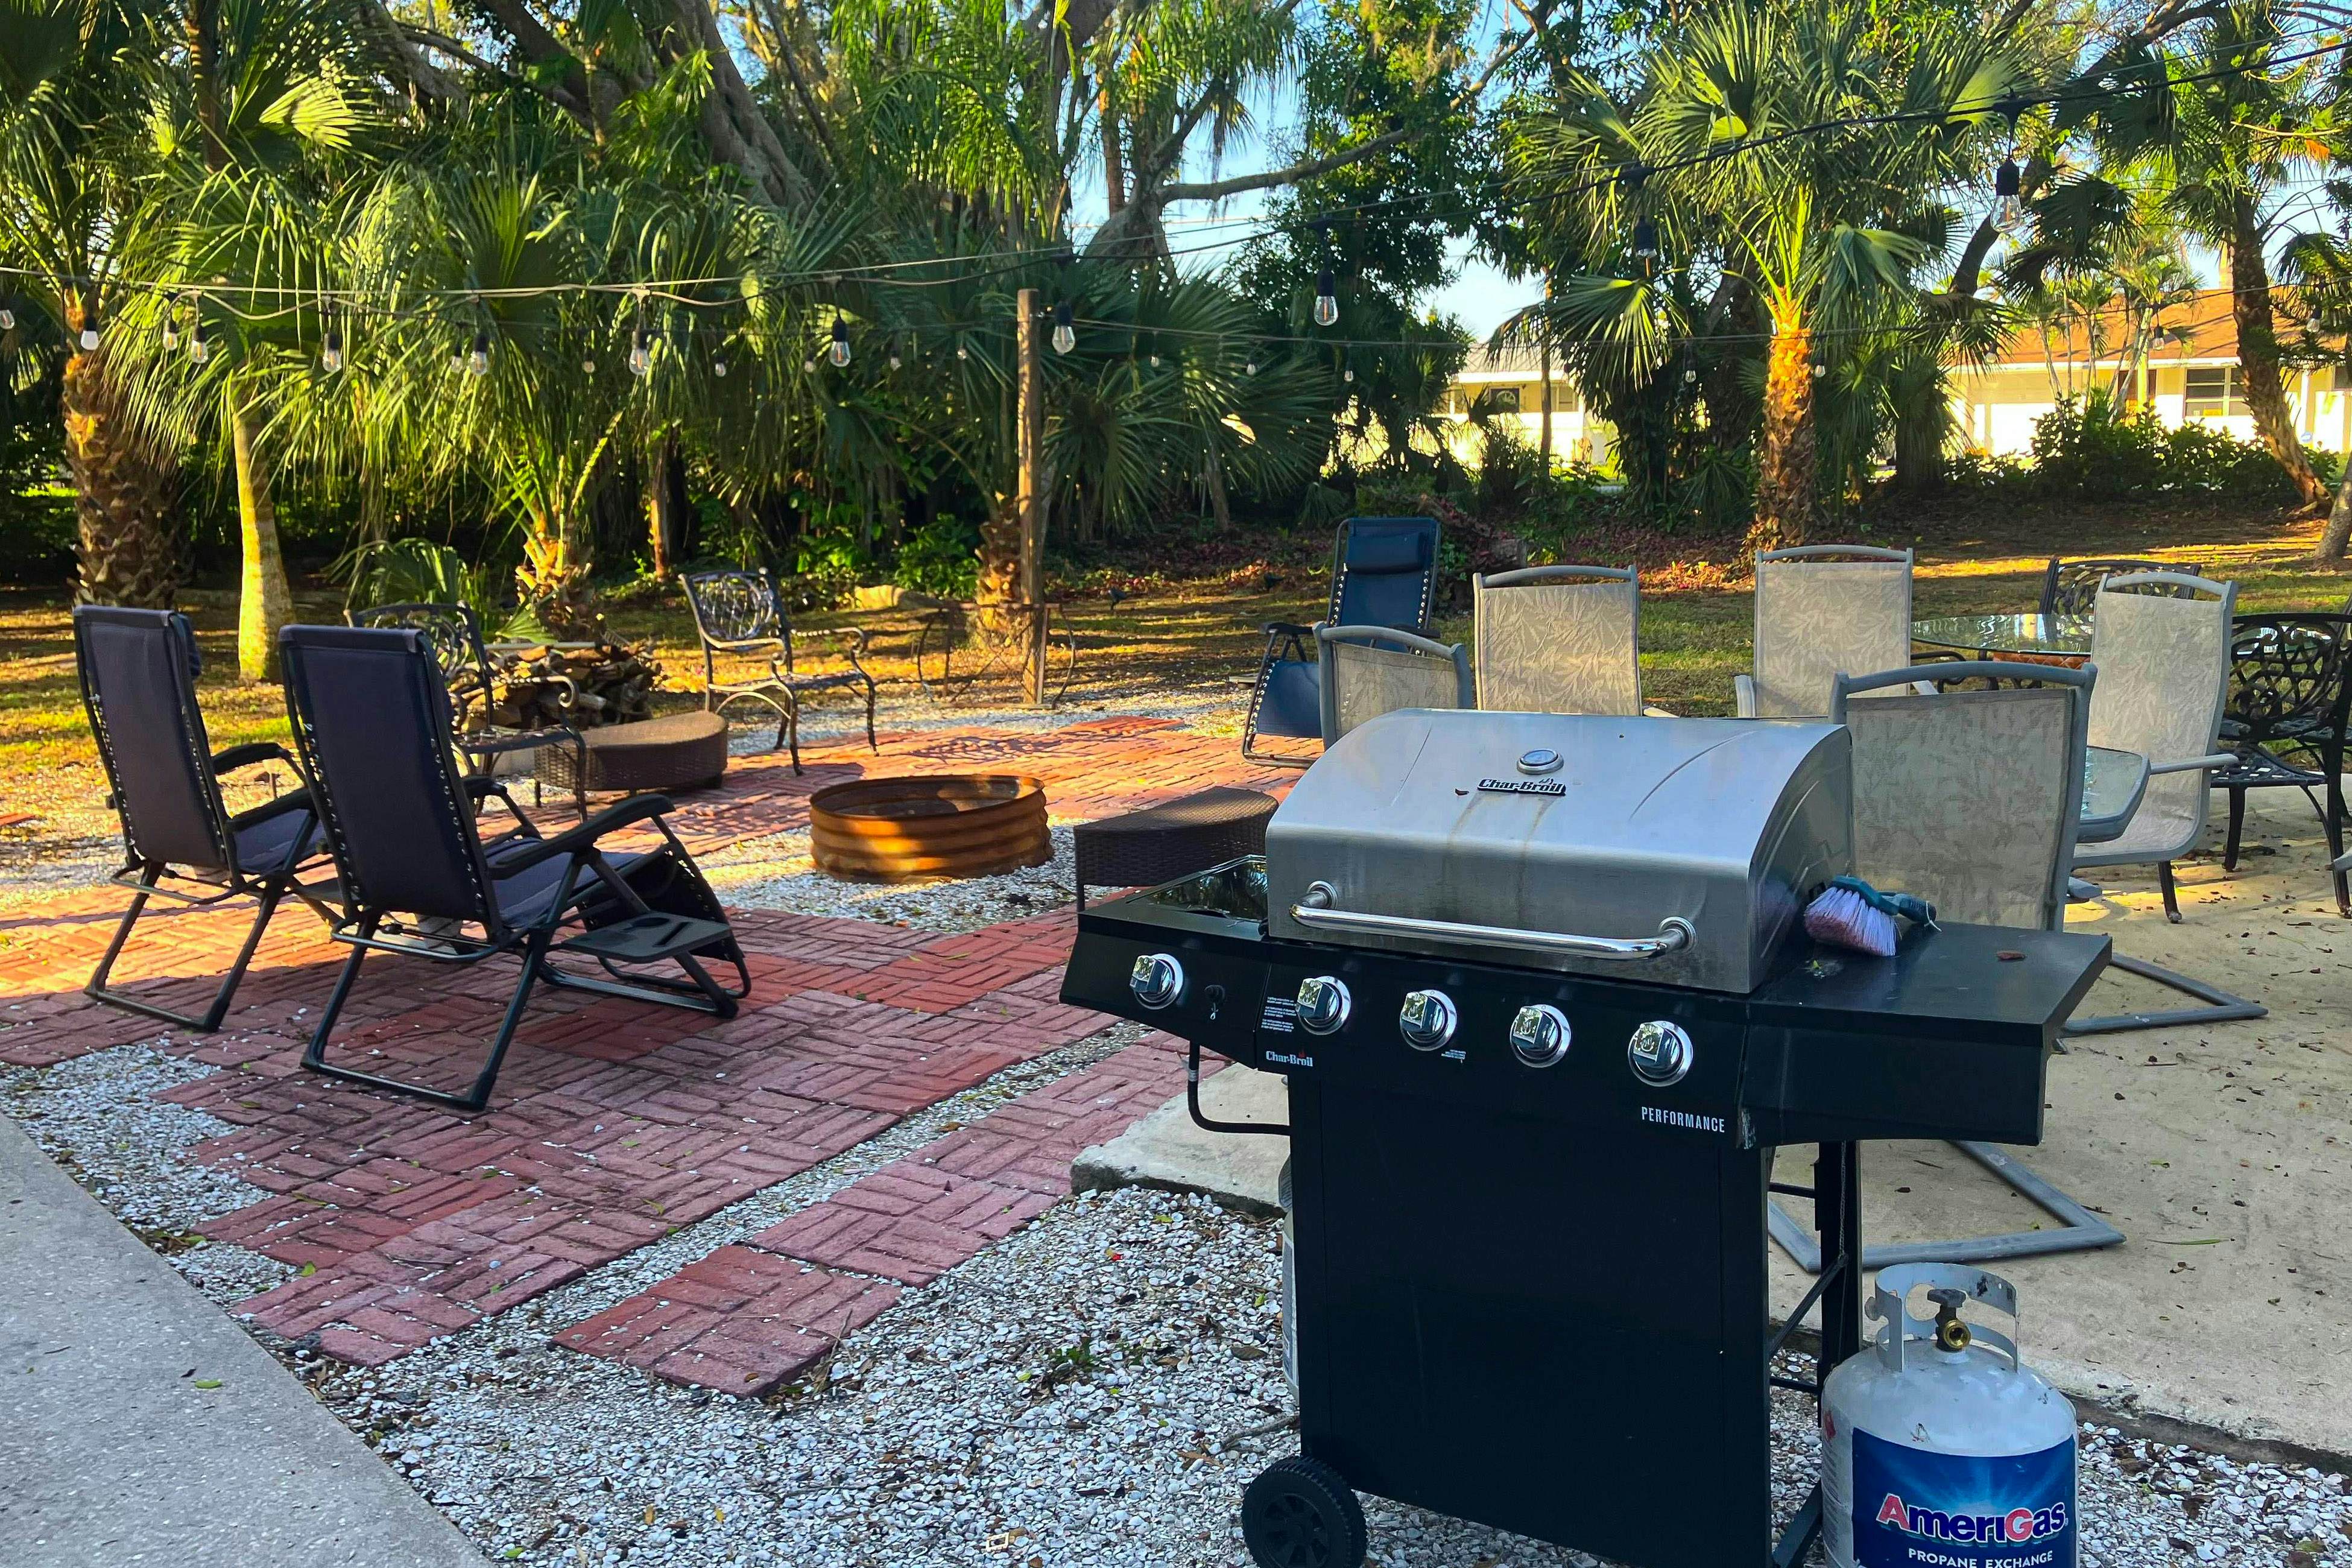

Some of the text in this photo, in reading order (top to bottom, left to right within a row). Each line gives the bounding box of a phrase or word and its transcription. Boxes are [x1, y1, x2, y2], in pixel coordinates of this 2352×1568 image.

[1478, 779, 1564, 793] Char-Broil
[1266, 1051, 1314, 1067] Char-Broil
[1642, 1106, 1725, 1133] PERFORMANCE
[1876, 1493, 2066, 1543] AmeriGas
[1908, 1548, 2053, 1568] PROPANE EXCHANGE
